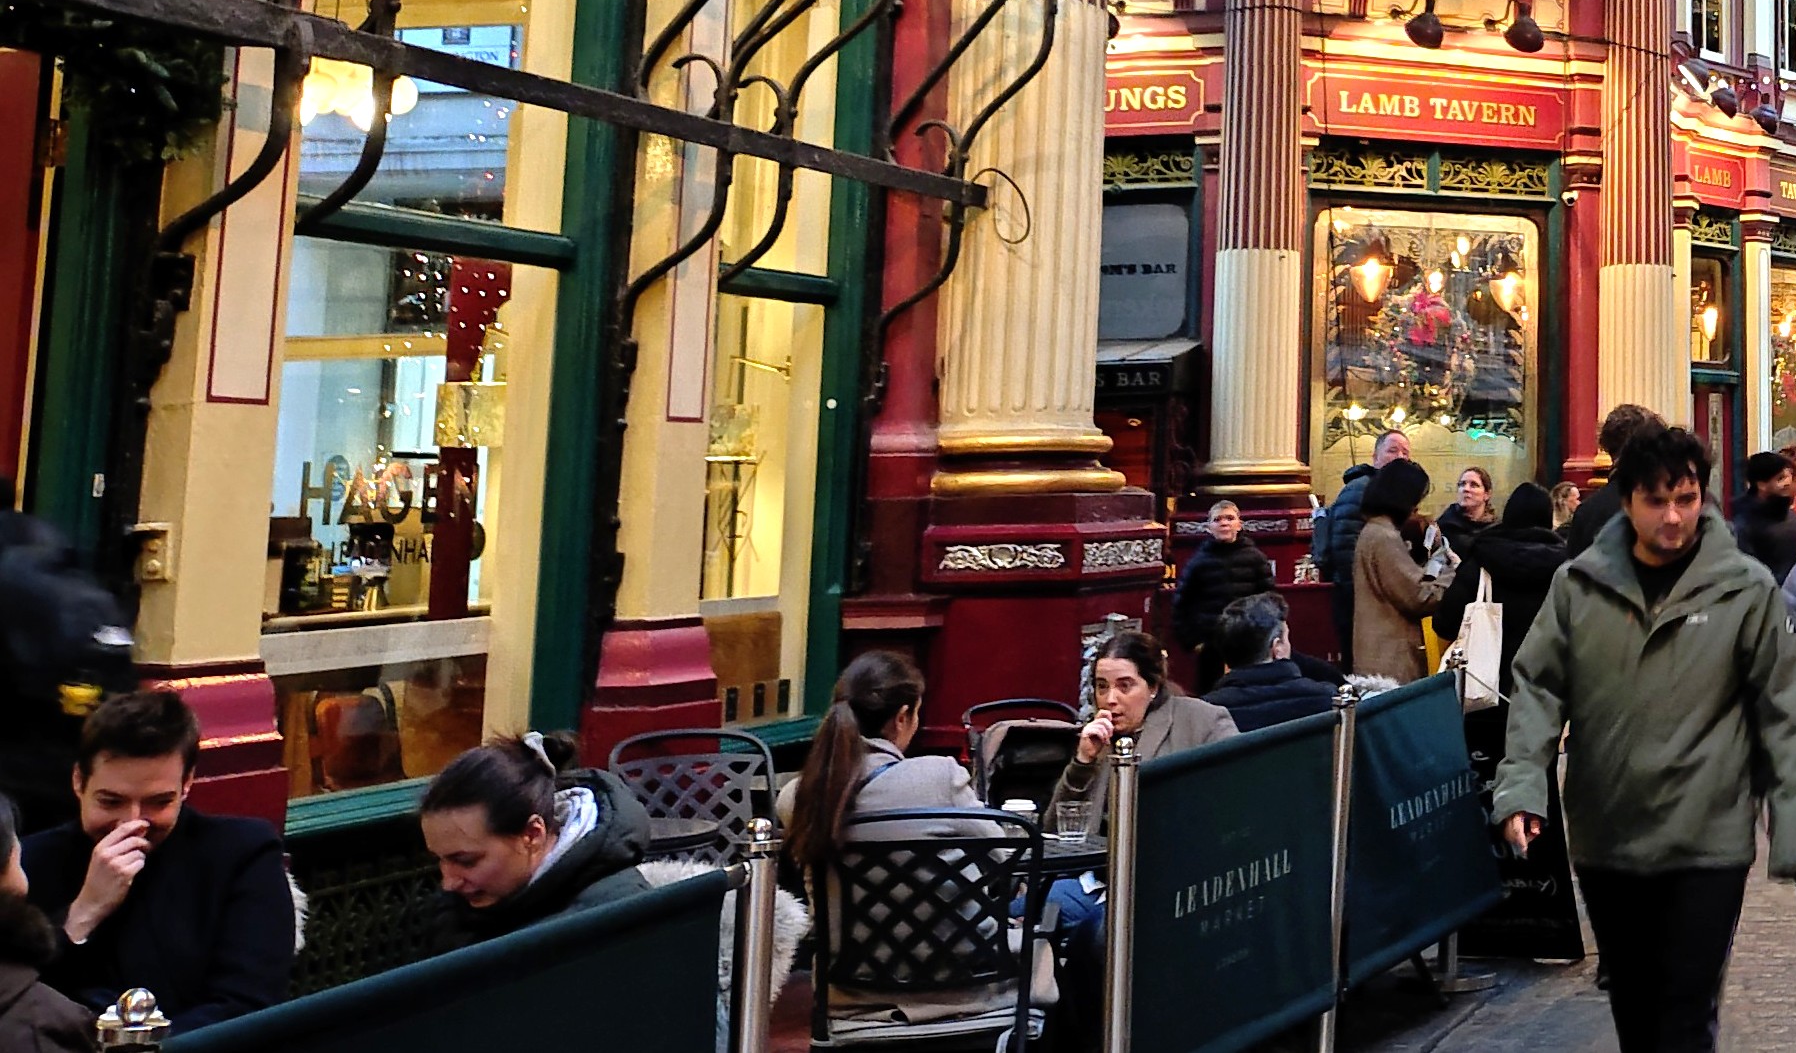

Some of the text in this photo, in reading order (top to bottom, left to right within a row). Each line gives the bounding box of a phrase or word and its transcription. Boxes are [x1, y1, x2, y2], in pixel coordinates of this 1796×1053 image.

[1338, 90, 1537, 127] LAMB TAVERN
[1694, 165, 1732, 188] LAMB
[1141, 263, 1177, 275] BAR
[1116, 372, 1162, 387] BAR
[300, 459, 478, 525] HAGEN
[1391, 773, 1471, 829] LEADENHALL
[1174, 849, 1291, 918] LEADENHALL
